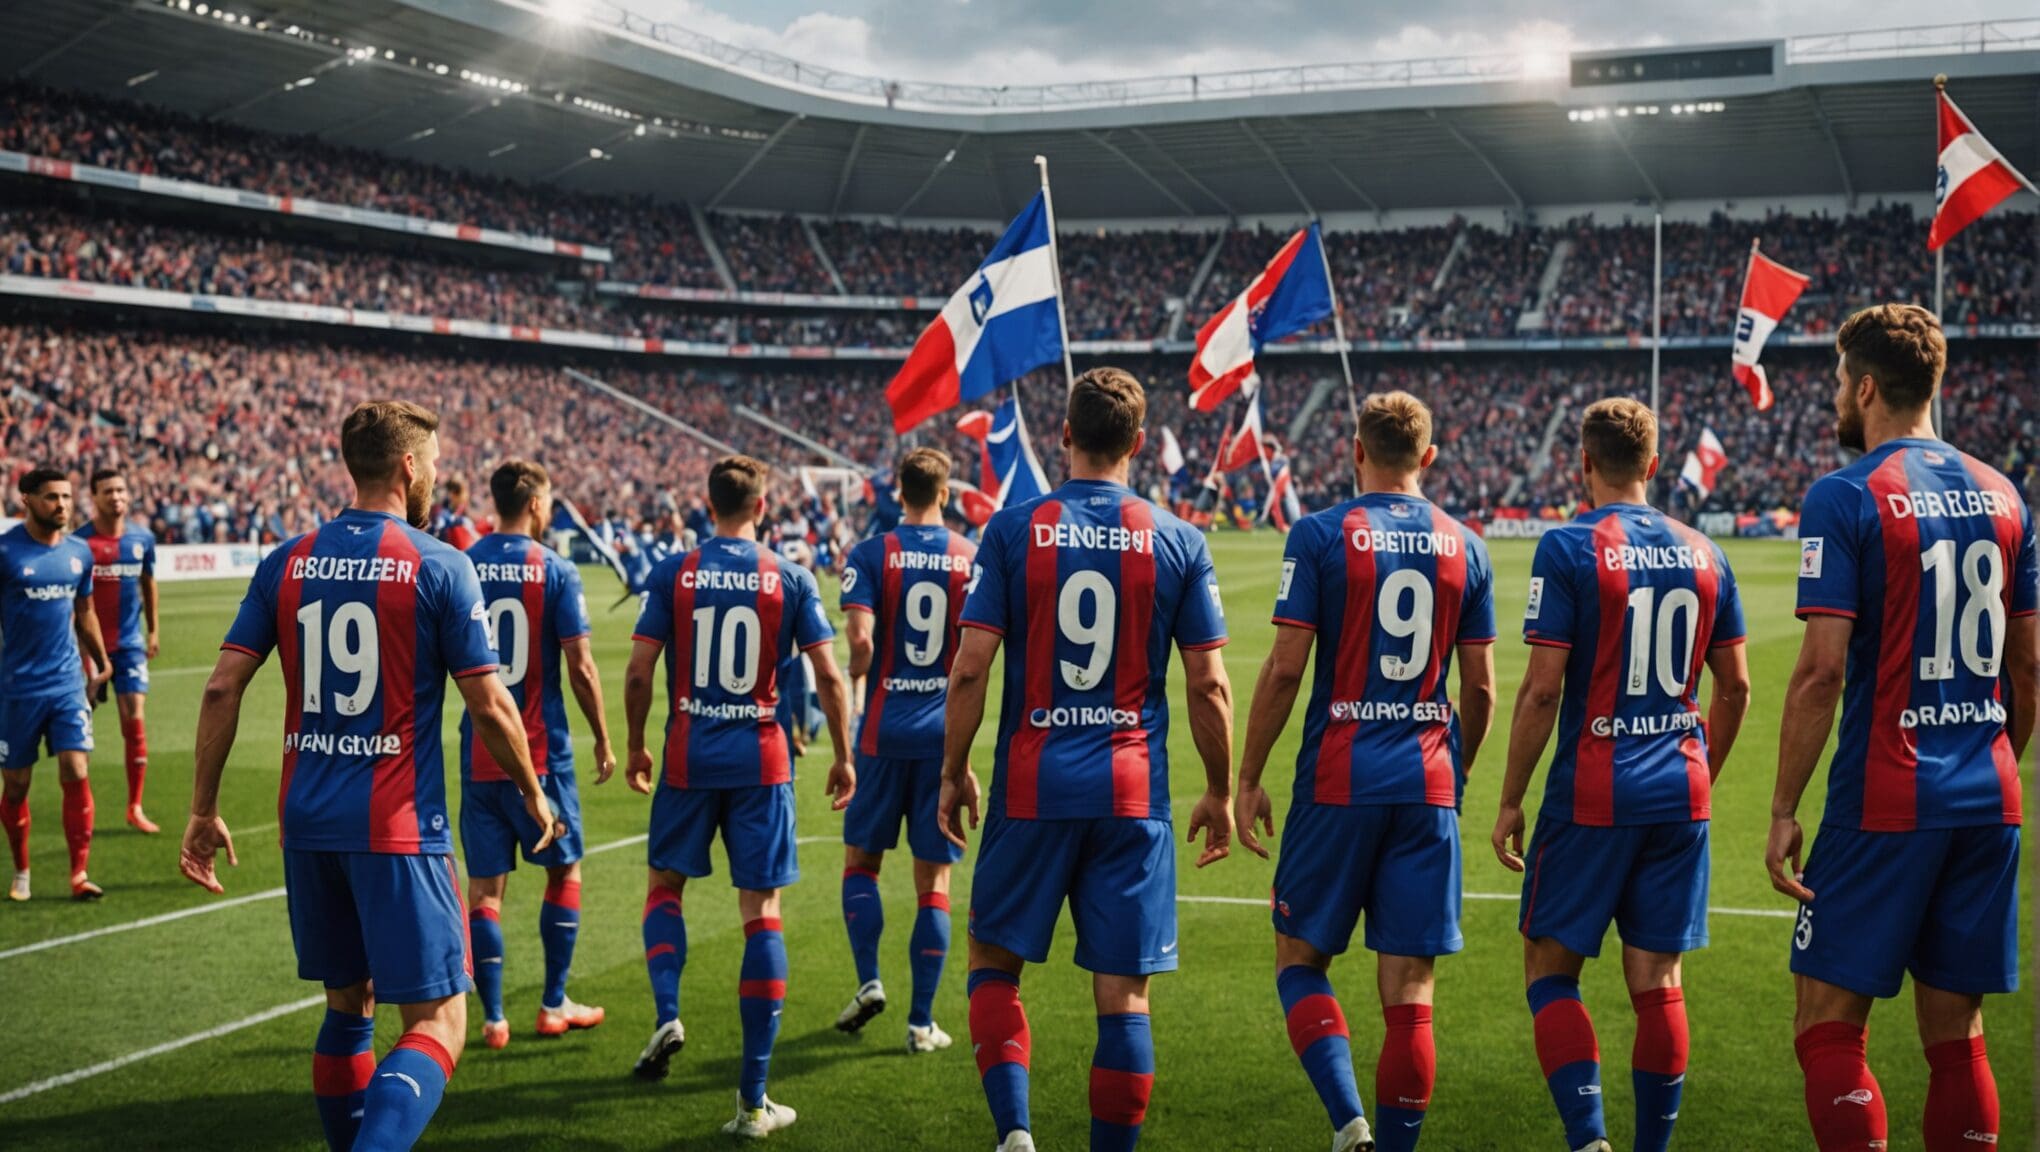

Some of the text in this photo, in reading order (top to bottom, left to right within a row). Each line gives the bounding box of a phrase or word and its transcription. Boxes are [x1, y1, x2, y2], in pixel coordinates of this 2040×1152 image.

[296, 599, 380, 716] 19
[693, 605, 762, 695] 10
[905, 581, 948, 667] 9
[1058, 569, 1116, 691] 9
[1378, 568, 1434, 681] 9
[1627, 587, 1700, 697] 10
[1921, 539, 2006, 681] 18
